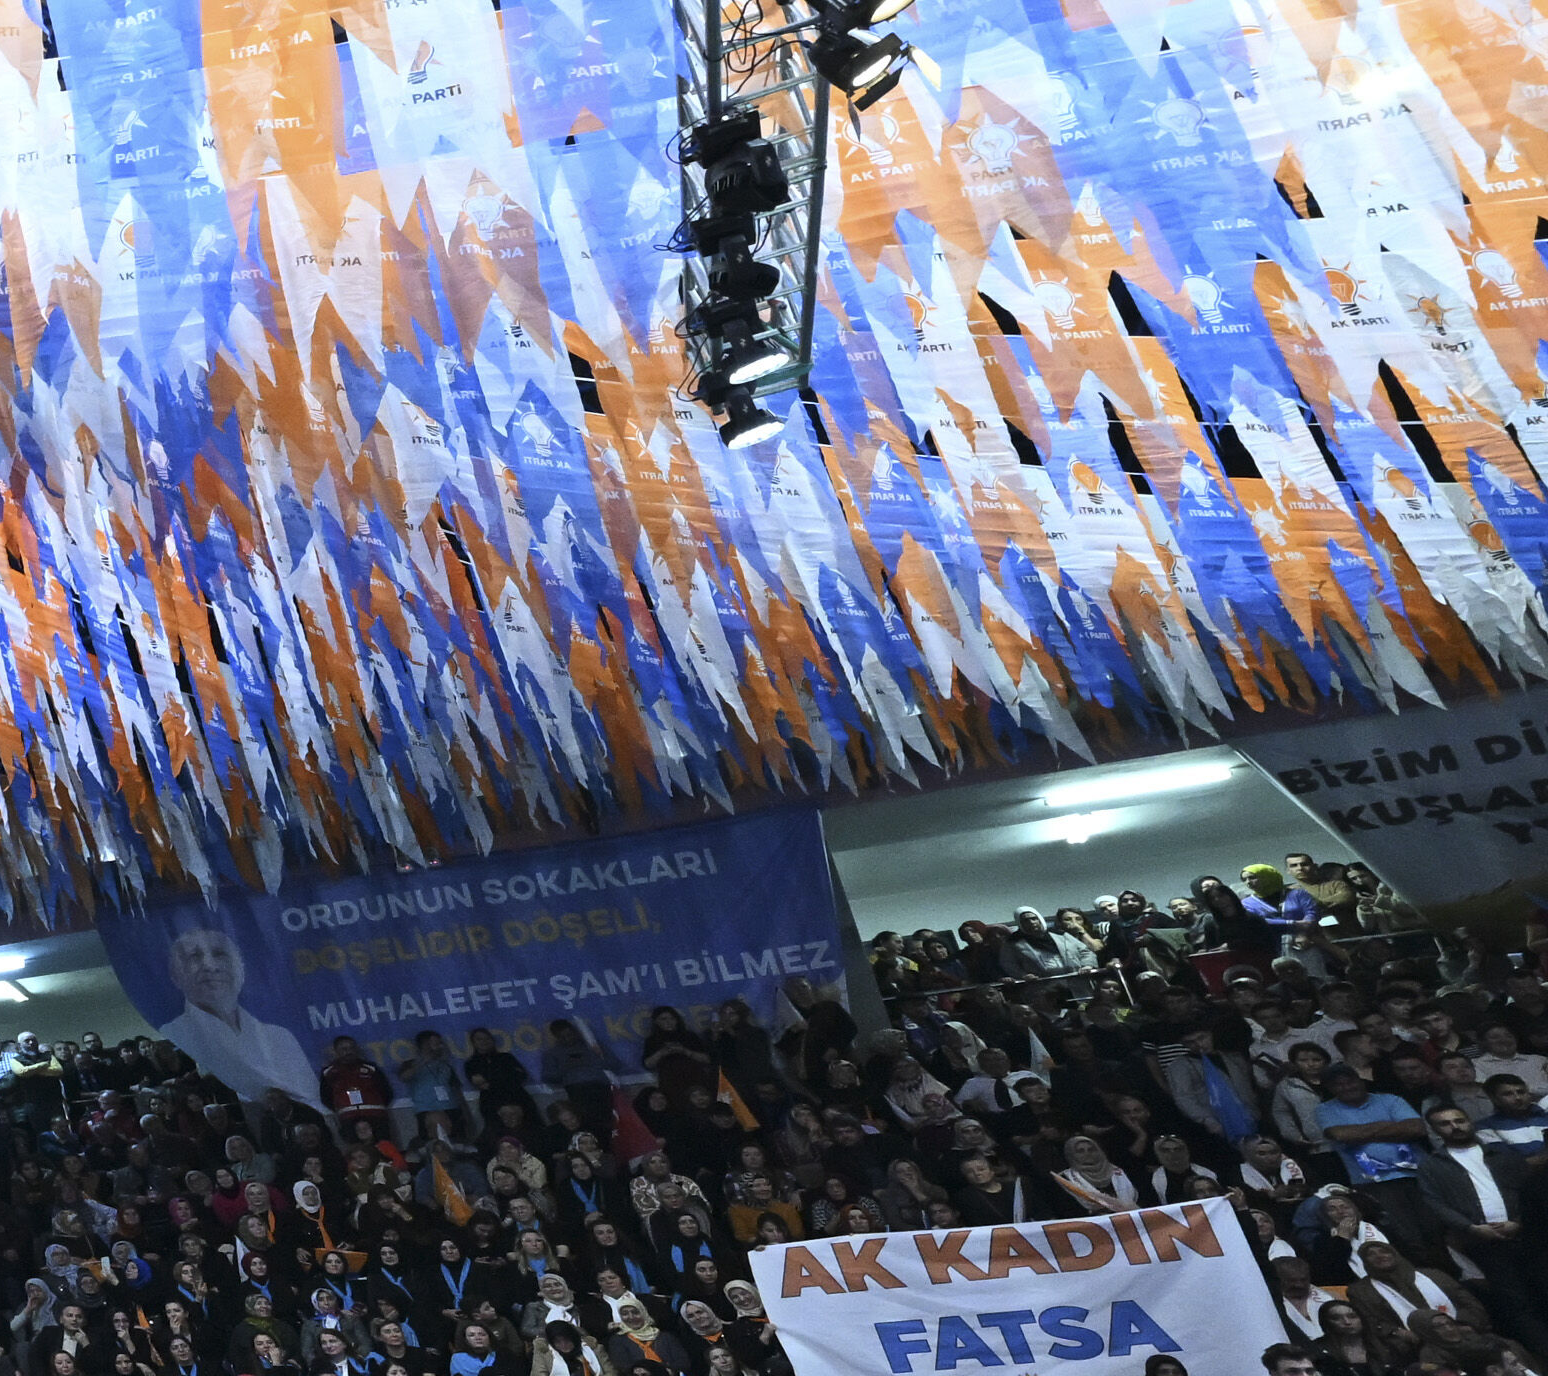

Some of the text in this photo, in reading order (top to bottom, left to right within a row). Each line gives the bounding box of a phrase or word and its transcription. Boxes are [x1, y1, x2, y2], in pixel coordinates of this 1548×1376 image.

[281, 848, 718, 932] ORDUNUN SOKAKLARI
[308, 976, 538, 1031] MUHALEFET
[674, 939, 836, 989] BİLMEZ
[780, 1203, 1225, 1299] AK KADIN
[874, 1299, 1183, 1374] FATSA
